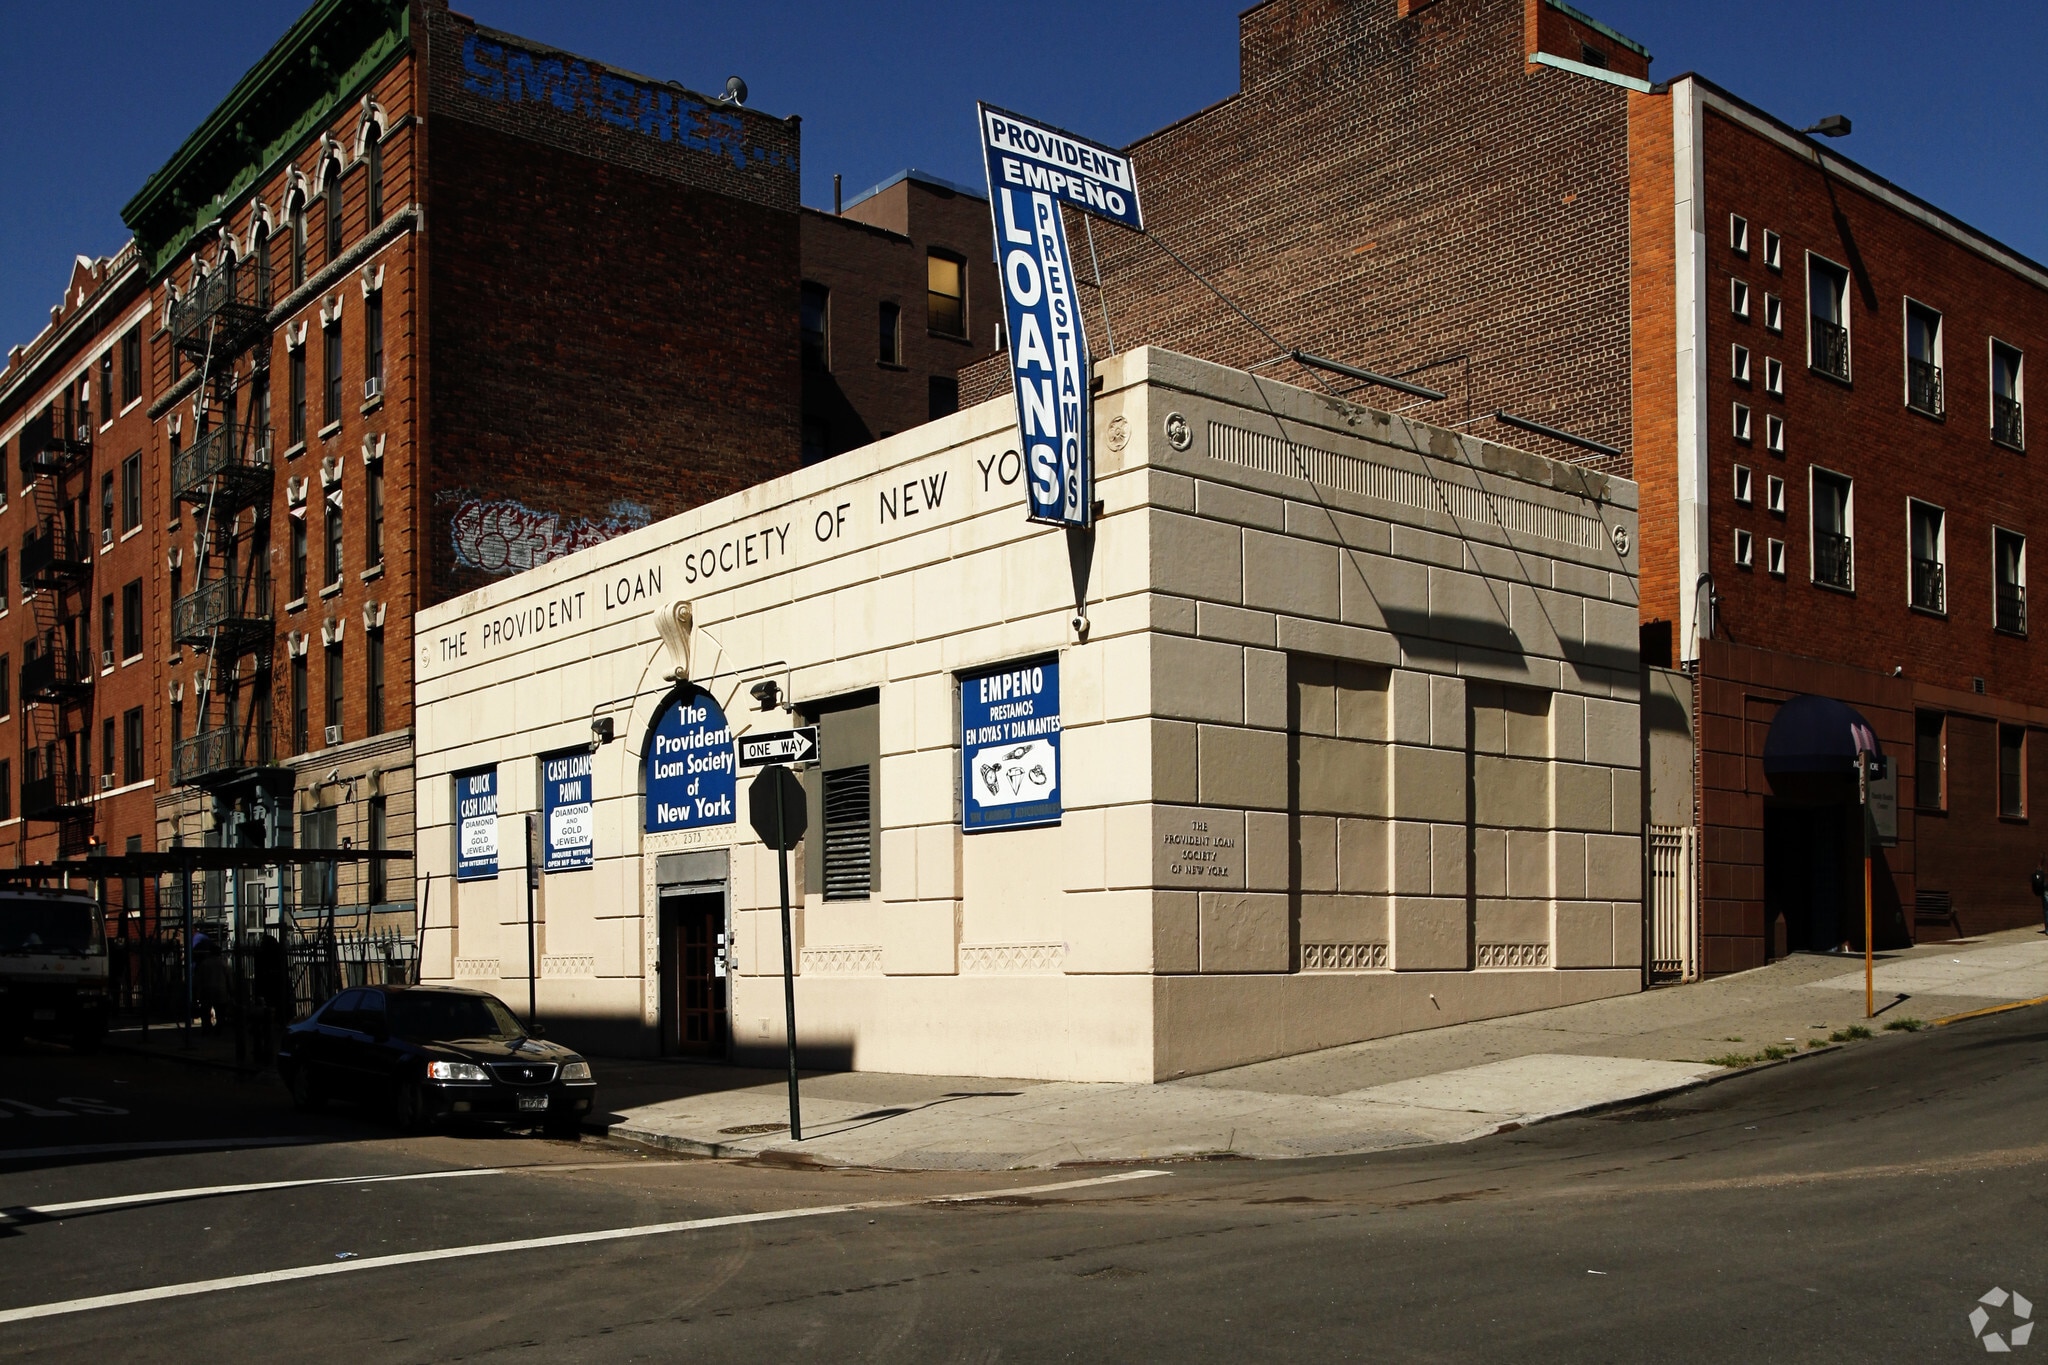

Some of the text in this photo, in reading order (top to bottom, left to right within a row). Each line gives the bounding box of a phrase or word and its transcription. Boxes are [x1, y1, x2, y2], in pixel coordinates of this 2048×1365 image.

[992, 118, 1121, 182] PROVIDENT
[1002, 157, 1126, 215] EMPEÑO
[1001, 188, 1059, 505] LOANS
[1037, 203, 1077, 508] PRESTAMOS
[440, 631, 467, 661] THE
[483, 592, 585, 649] PROVIDENT
[606, 565, 661, 610] LOAN
[685, 523, 790, 583] SOCIETY
[815, 503, 850, 541] OF
[880, 471, 947, 524] NEW
[977, 450, 1021, 491] YO
[678, 705, 707, 726] The
[990, 700, 1033, 721] PRESTAMOS
[656, 725, 730, 755] Provident
[966, 715, 1060, 745] EN JOYAS Y DIAMANTES
[750, 739, 804, 757] ONE WAY
[548, 759, 568, 782] CASH
[655, 751, 734, 780] Loan Society
[470, 773, 490, 795] QUICK
[560, 780, 582, 803] PAWN
[687, 778, 699, 796] of
[461, 795, 497, 818] CASH LOAN
[555, 806, 588, 818] DIAMOND
[657, 794, 731, 824] New York
[465, 817, 494, 829] DIAMOND
[562, 826, 582, 836] GOLD
[1192, 821, 1207, 832] THE
[466, 844, 494, 855] JEWELRY
[471, 836, 488, 845] GOLD
[555, 835, 588, 846] JEWELRY
[1164, 835, 1234, 848] PROVIDENT LOAN
[548, 860, 560, 868] OPEN
[1182, 850, 1217, 861] SOCIETY
[1171, 864, 1228, 877] OF NEW YORK
